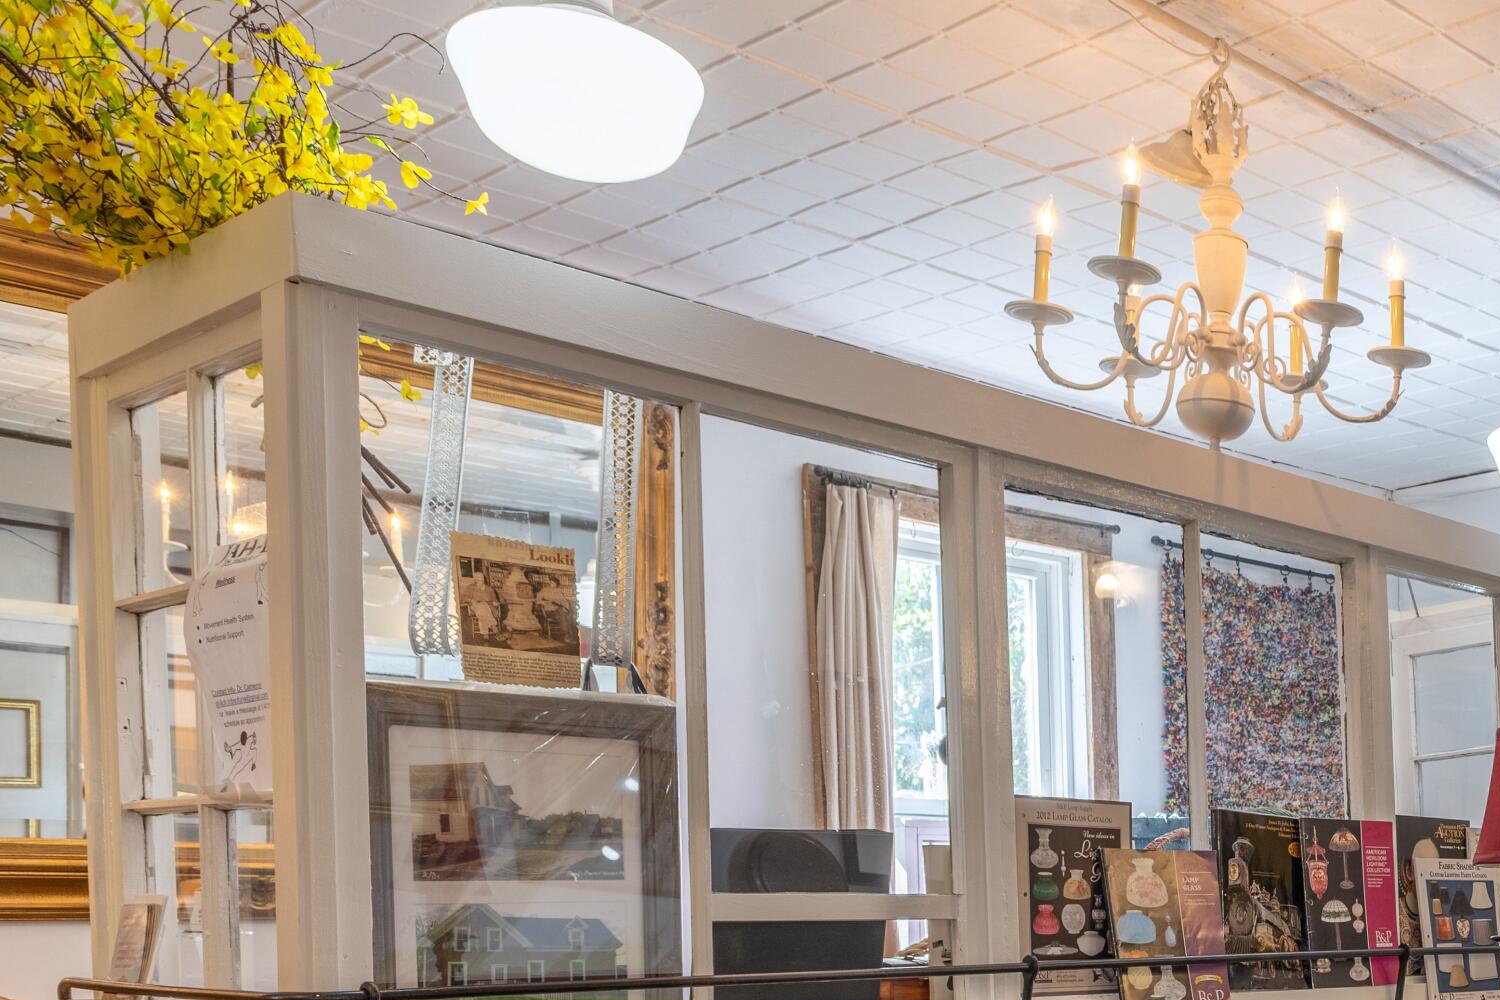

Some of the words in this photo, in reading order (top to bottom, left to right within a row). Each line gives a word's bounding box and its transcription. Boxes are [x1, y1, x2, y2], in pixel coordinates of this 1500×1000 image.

[223, 616, 238, 624] Health
[238, 613, 255, 623] System
[226, 629, 244, 640] Support
[1375, 930, 1392, 943] B&P
